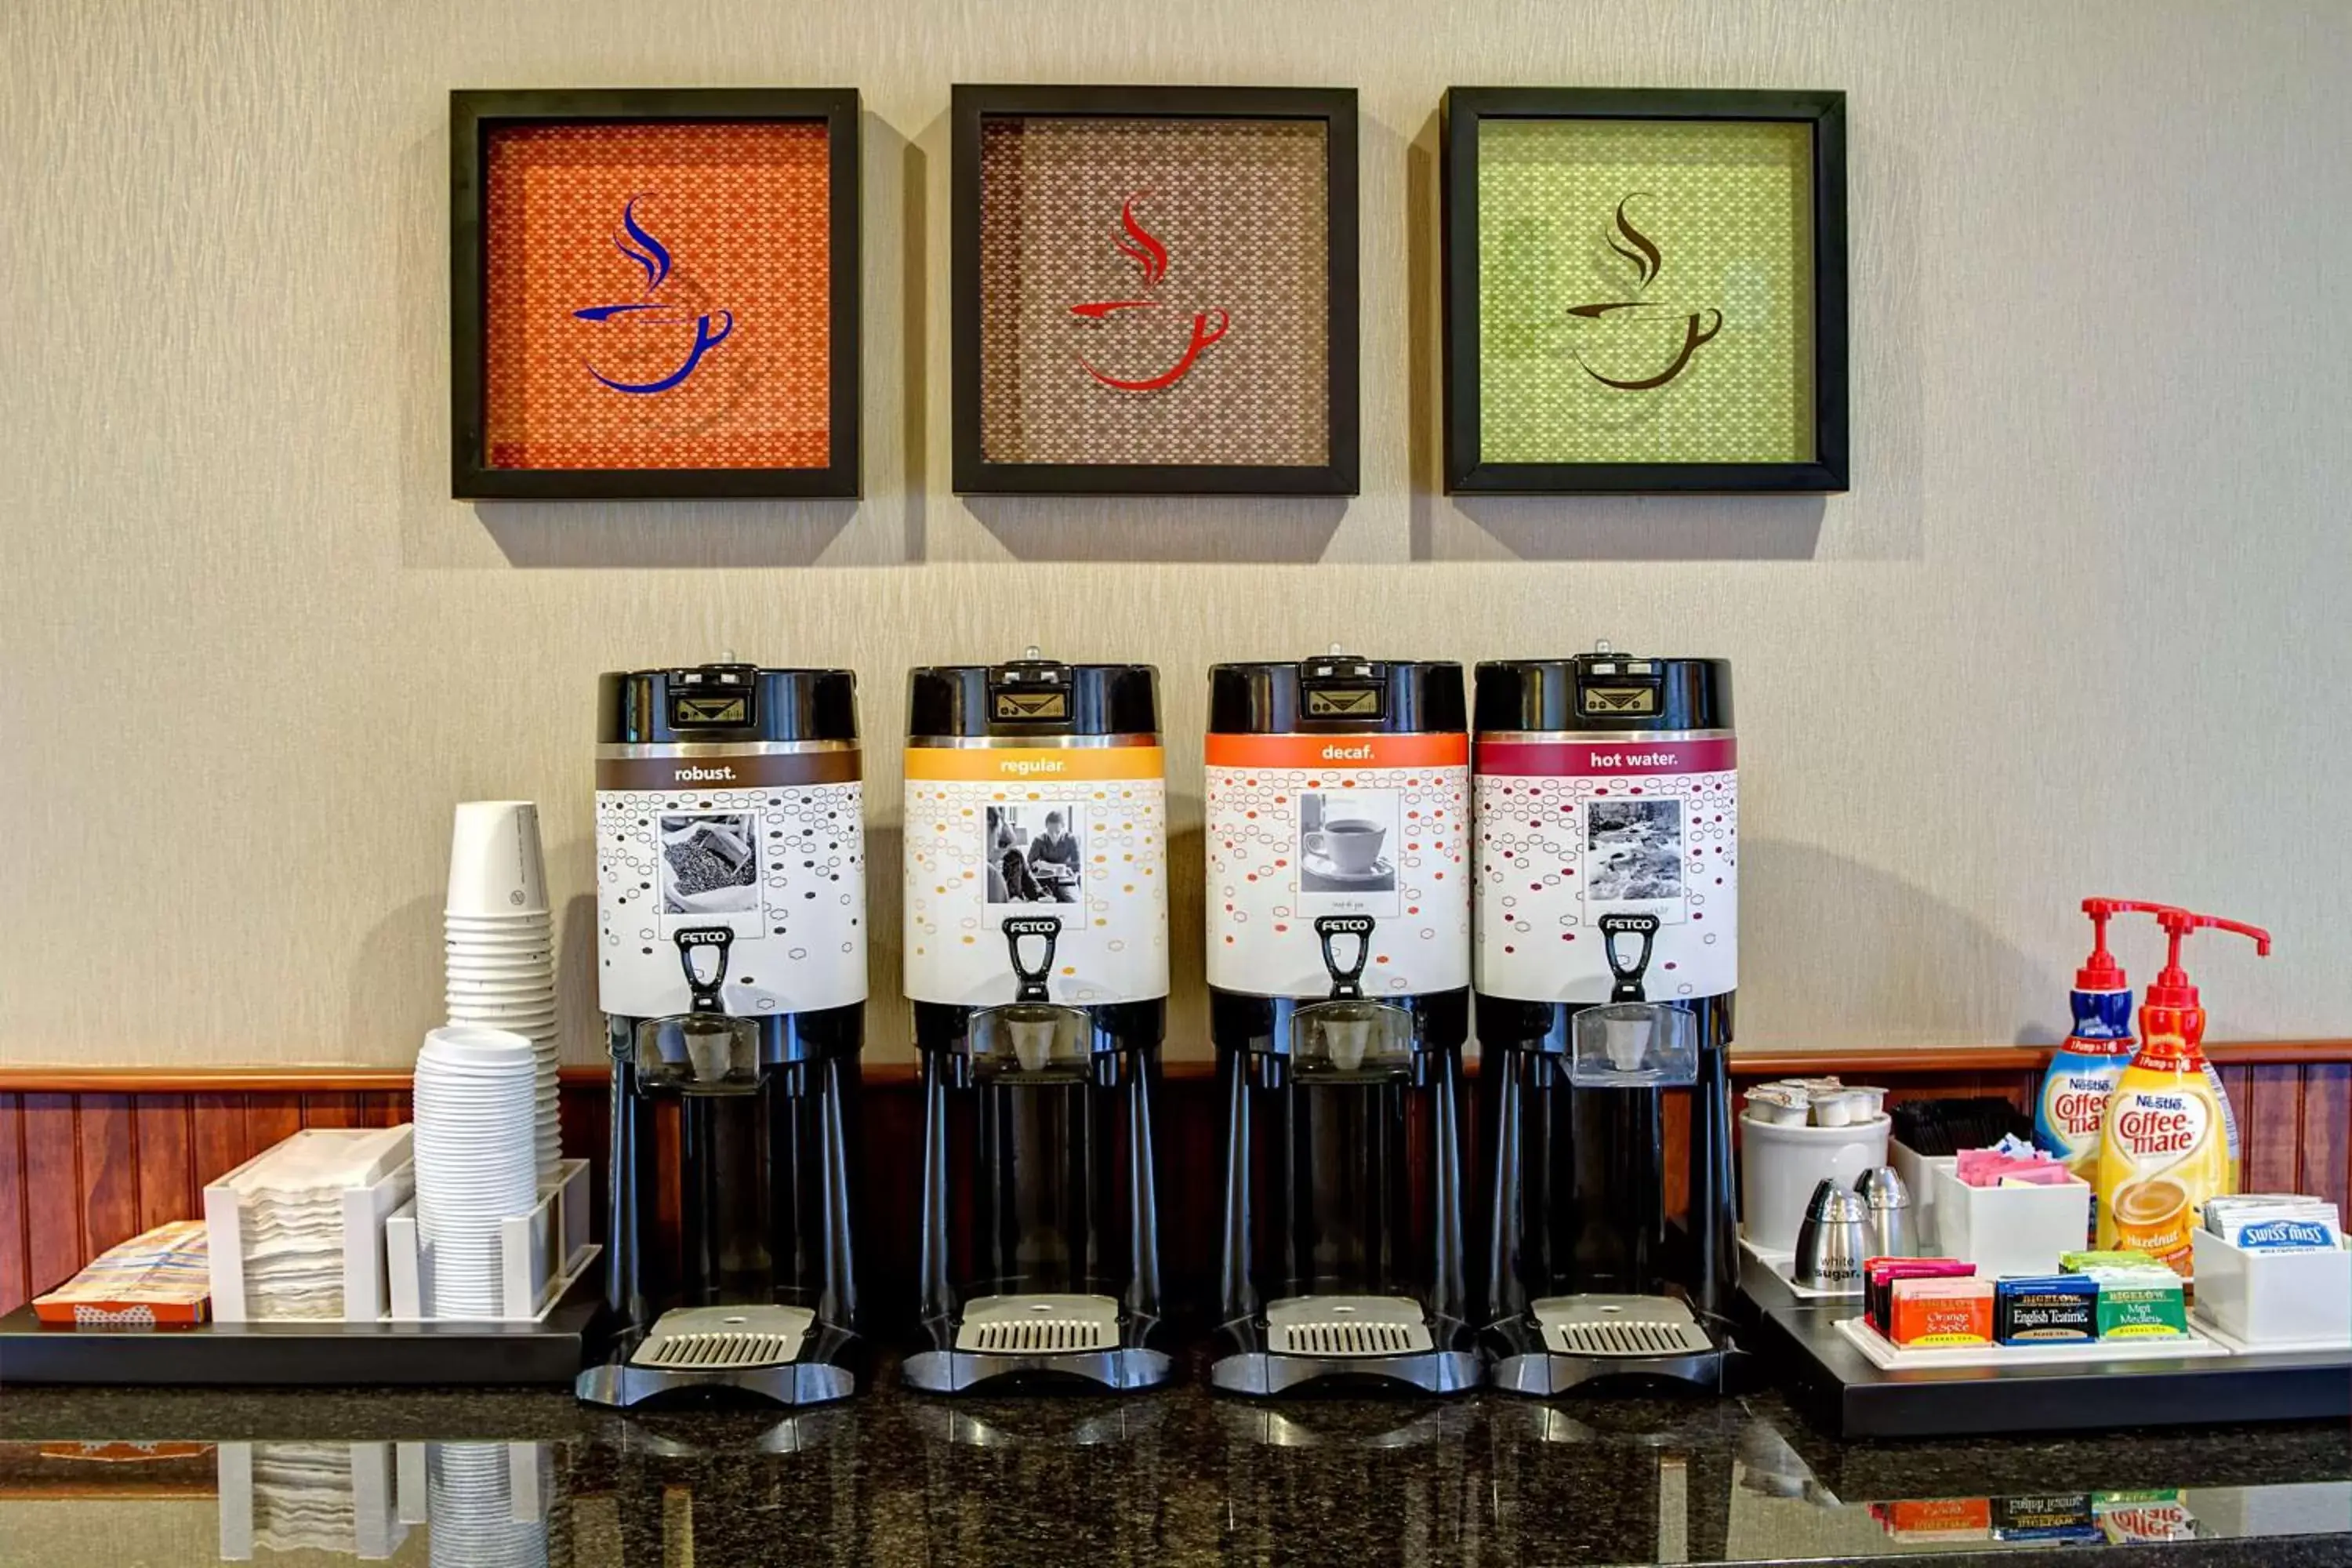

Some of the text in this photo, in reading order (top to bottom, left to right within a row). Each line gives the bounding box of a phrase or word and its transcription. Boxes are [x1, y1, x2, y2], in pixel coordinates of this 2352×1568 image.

[1321, 743, 1375, 760] decaf.
[1000, 757, 1067, 775] regular.
[1590, 752, 1679, 768] hot water.
[675, 765, 736, 781] robust.
[1011, 921, 1056, 933] FETCO
[1321, 920, 1368, 931] FETCO
[1606, 919, 1653, 929] FETCO
[680, 931, 727, 943] FETCO
[2133, 1131, 2192, 1154] mate
[1820, 1256, 1854, 1268] white
[1815, 1269, 1860, 1282] sugar.
[1926, 1312, 1970, 1324] Orange
[2013, 1309, 2049, 1327] English
